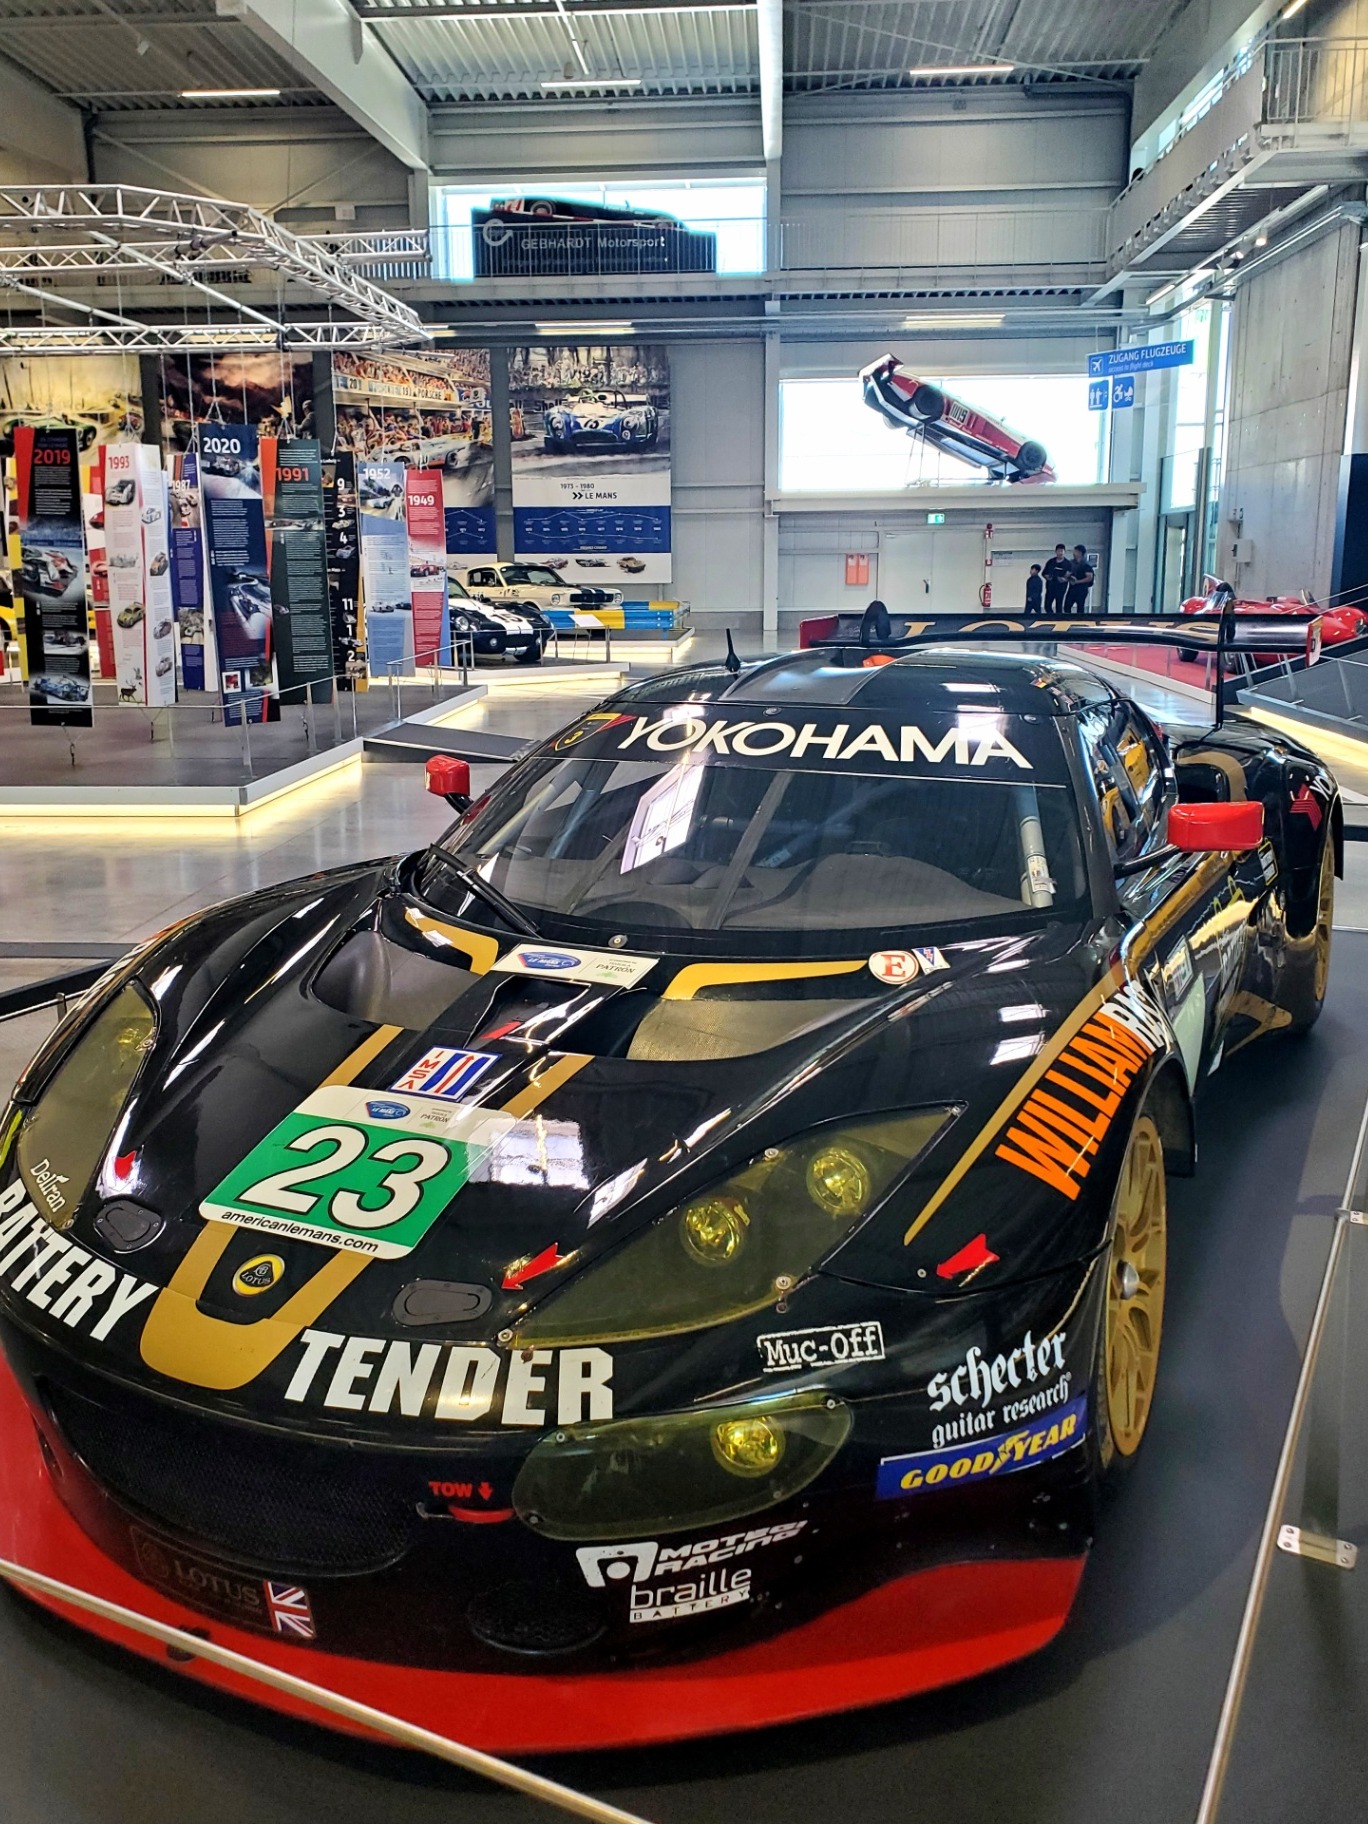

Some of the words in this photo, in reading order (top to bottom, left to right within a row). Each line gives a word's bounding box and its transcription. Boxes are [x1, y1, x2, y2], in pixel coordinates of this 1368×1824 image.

[521, 237, 592, 250] GEBHARDT
[597, 235, 665, 249] Motorsport
[1108, 351, 1139, 364] ZUGANG
[1140, 343, 1187, 359] FLUGZEUGE
[203, 437, 241, 454] 2020
[33, 449, 71, 465] 2019
[108, 456, 130, 470] 1993
[275, 467, 309, 482] 1991
[363, 468, 391, 480] 1952
[171, 480, 191, 492] 1987
[337, 478, 345, 490] 9
[408, 495, 435, 506] 1949
[595, 492, 618, 500] MANS
[338, 506, 346, 518] 3
[339, 532, 348, 544] 4
[342, 598, 353, 611] 11
[347, 651, 355, 661] 2
[617, 716, 1034, 769] YOKOHAMA
[880, 955, 906, 978] E
[398, 1050, 444, 1090] IMSA
[231, 1122, 453, 1231] 23
[220, 1208, 380, 1254] americanlemans.com
[241, 1271, 271, 1285] LOTUS
[764, 1325, 879, 1367] Muc-Off
[284, 1328, 614, 1426] TENDER
[931, 1410, 996, 1450] guitar
[900, 1412, 1078, 1491] GOODYEAR
[428, 1481, 473, 1499] TOW
[173, 1559, 260, 1607] LOTUS
[630, 1568, 752, 1610] braille
[633, 1590, 747, 1620] BATTERY
